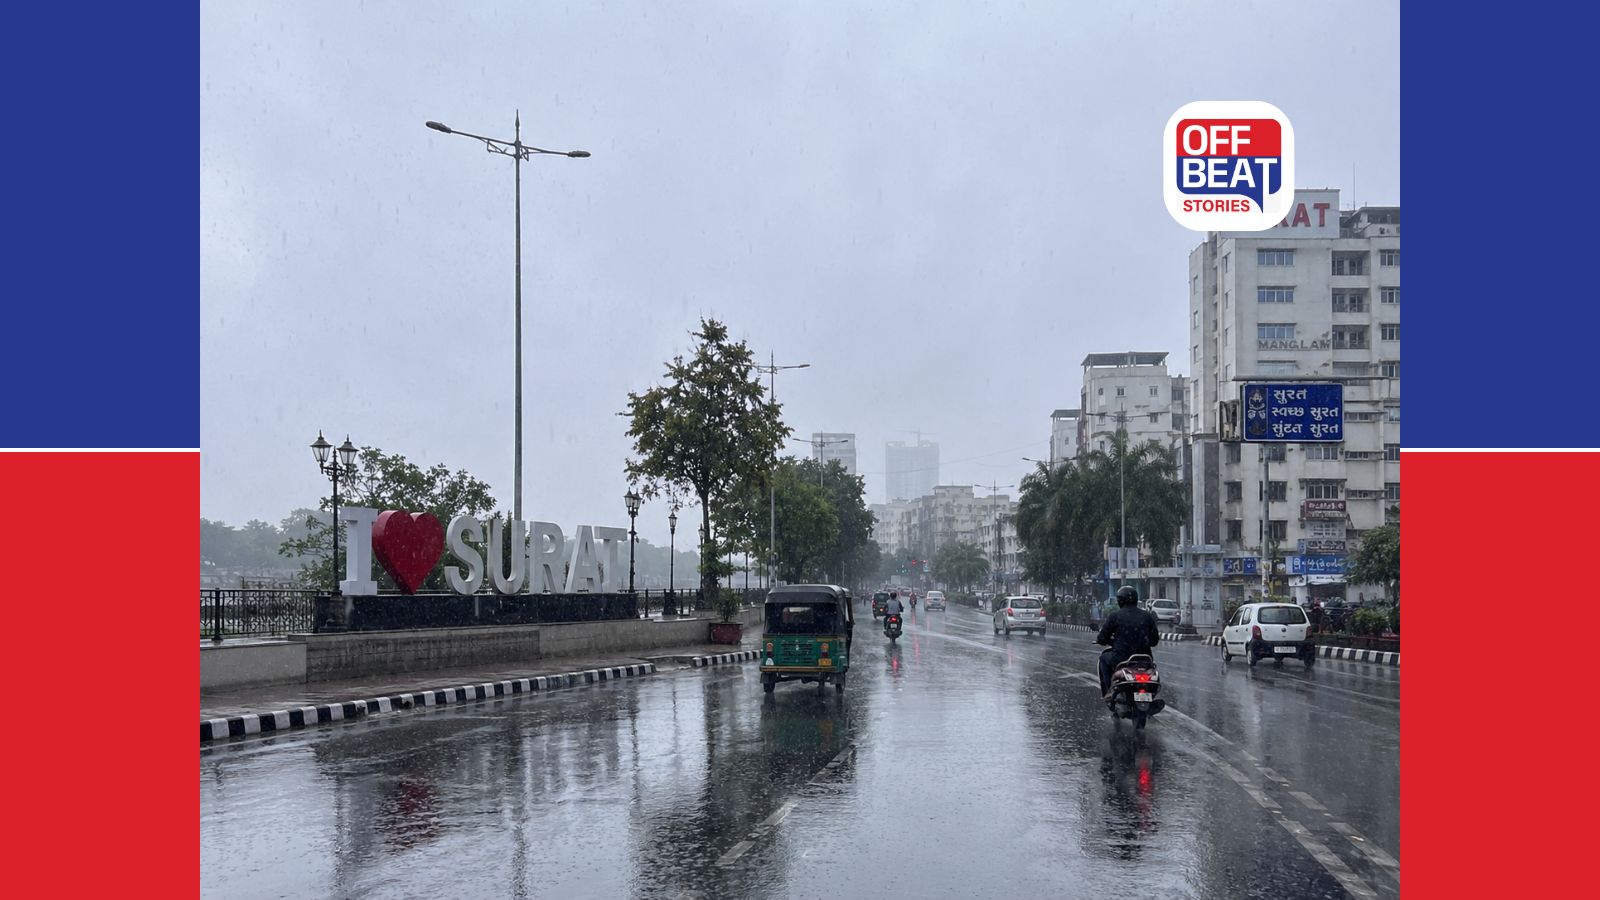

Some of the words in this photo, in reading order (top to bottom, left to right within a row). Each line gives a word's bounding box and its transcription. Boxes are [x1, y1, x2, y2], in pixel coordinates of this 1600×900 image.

[1257, 339, 1331, 350] MANGLAM
[1273, 388, 1308, 404] સુરત
[1310, 407, 1339, 421] સુરત
[1309, 423, 1339, 438] સુરત
[339, 507, 378, 595] I
[445, 515, 628, 595] SURAT
